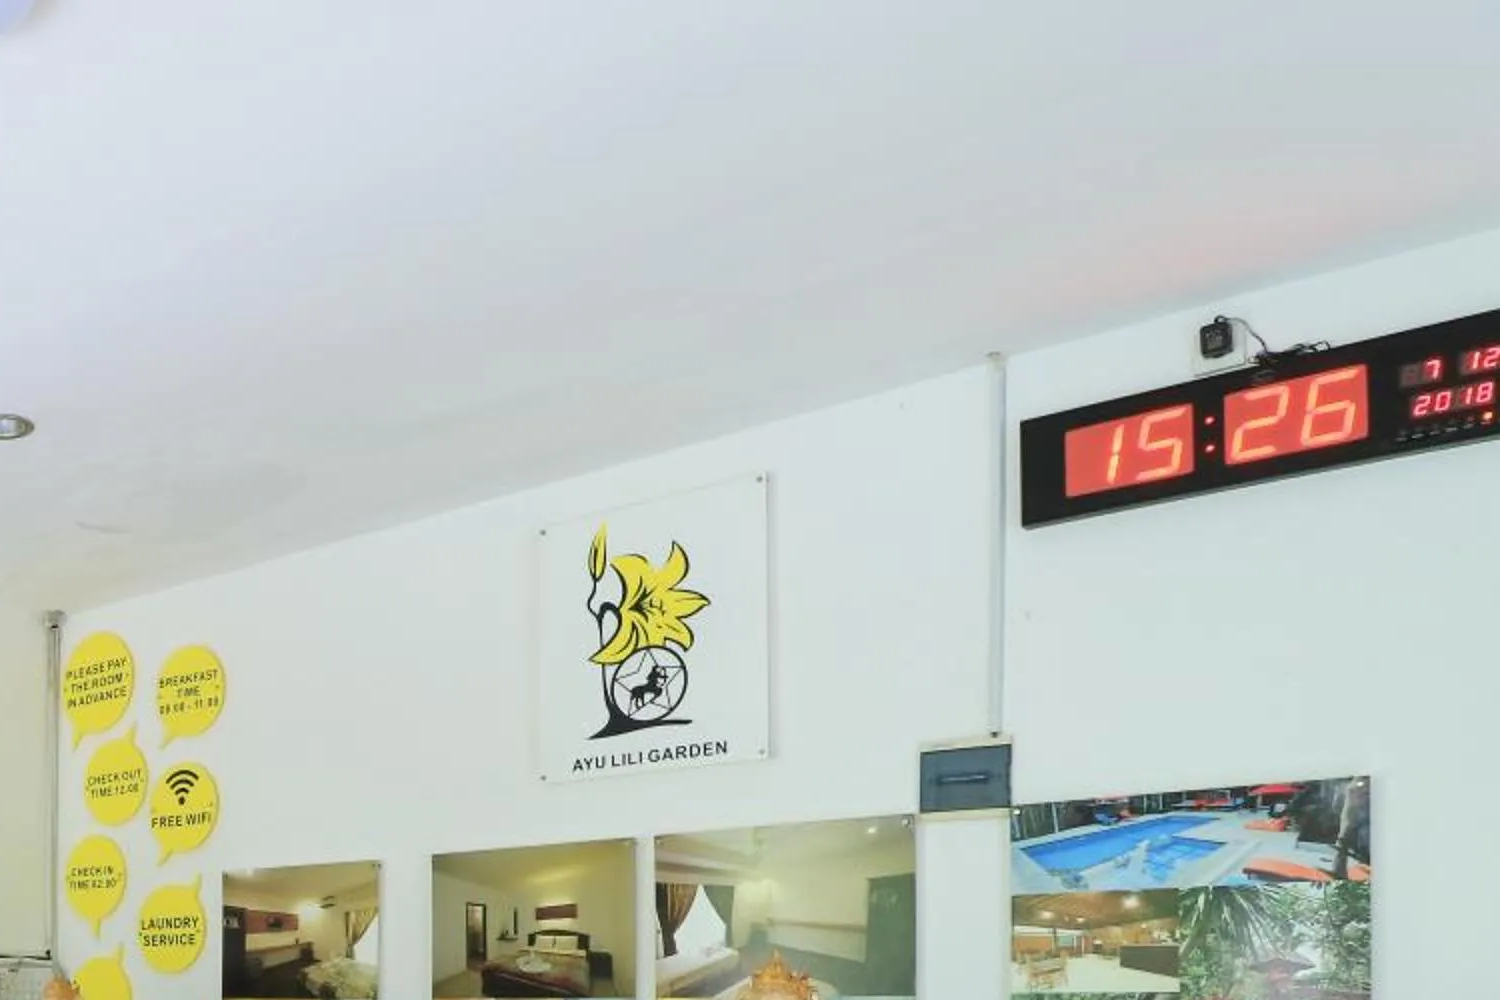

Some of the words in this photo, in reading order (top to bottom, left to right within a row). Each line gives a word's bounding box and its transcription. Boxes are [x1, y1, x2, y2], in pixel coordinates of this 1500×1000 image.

[1426, 359, 1442, 380] 7
[1472, 347, 1500, 370] 12
[1413, 381, 1494, 416] 2018
[1105, 366, 1358, 484] 15:26
[66, 661, 105, 680] PLEASE
[107, 656, 127, 671] PAY
[71, 681, 89, 694] THE
[92, 672, 123, 689] ROOM
[159, 668, 218, 689] BREAKFAST
[79, 685, 127, 705] ADVANCE
[177, 685, 201, 699] TIME
[572, 755, 606, 773] AYU
[611, 751, 643, 768] LILI
[647, 741, 727, 763] GARDEN
[87, 772, 119, 787] CHECK
[121, 768, 141, 781] OUT
[90, 786, 112, 800] TIME
[151, 815, 182, 829] FREE
[71, 866, 102, 877] CHECK
[103, 865, 114, 876] IN
[70, 879, 89, 892] TIME
[141, 916, 199, 931] LAUNDRY
[143, 934, 196, 947] SERVICE
